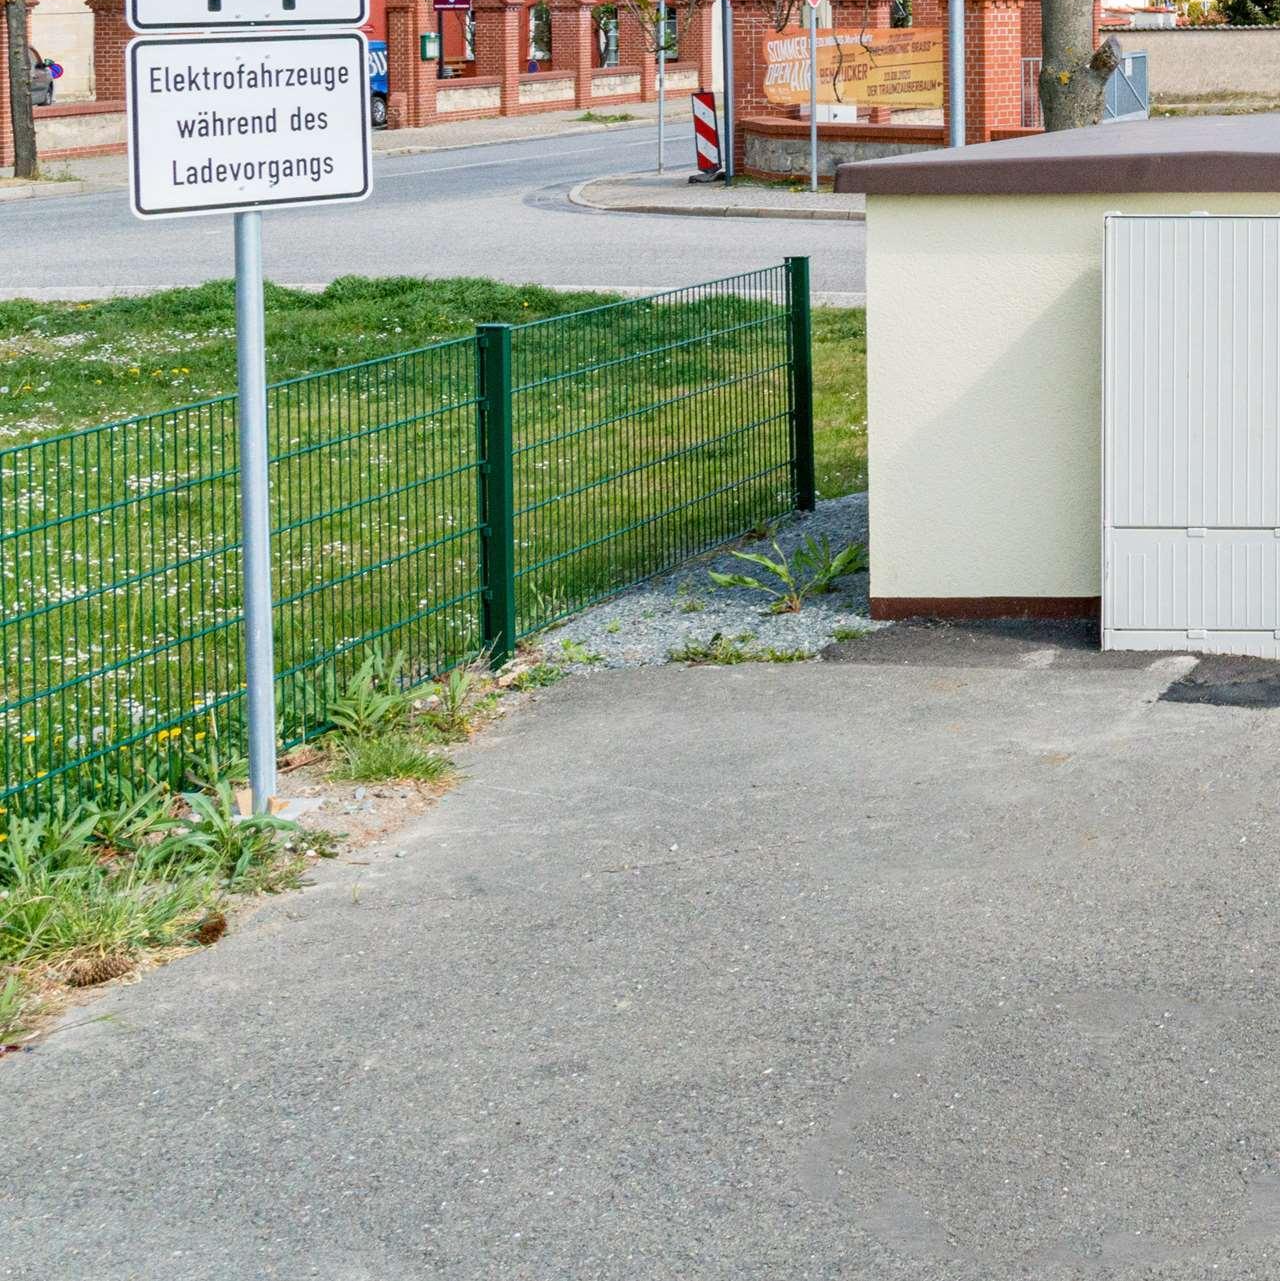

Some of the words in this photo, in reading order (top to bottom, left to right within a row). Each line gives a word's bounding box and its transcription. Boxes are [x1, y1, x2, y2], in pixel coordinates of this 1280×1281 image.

[767, 37, 811, 62] SOMMER
[150, 62, 349, 93] Elektrofahrzeuge
[765, 62, 792, 86] OPEN
[176, 107, 277, 139] während
[290, 106, 328, 132] des
[172, 155, 334, 186] Ladevorgangs
